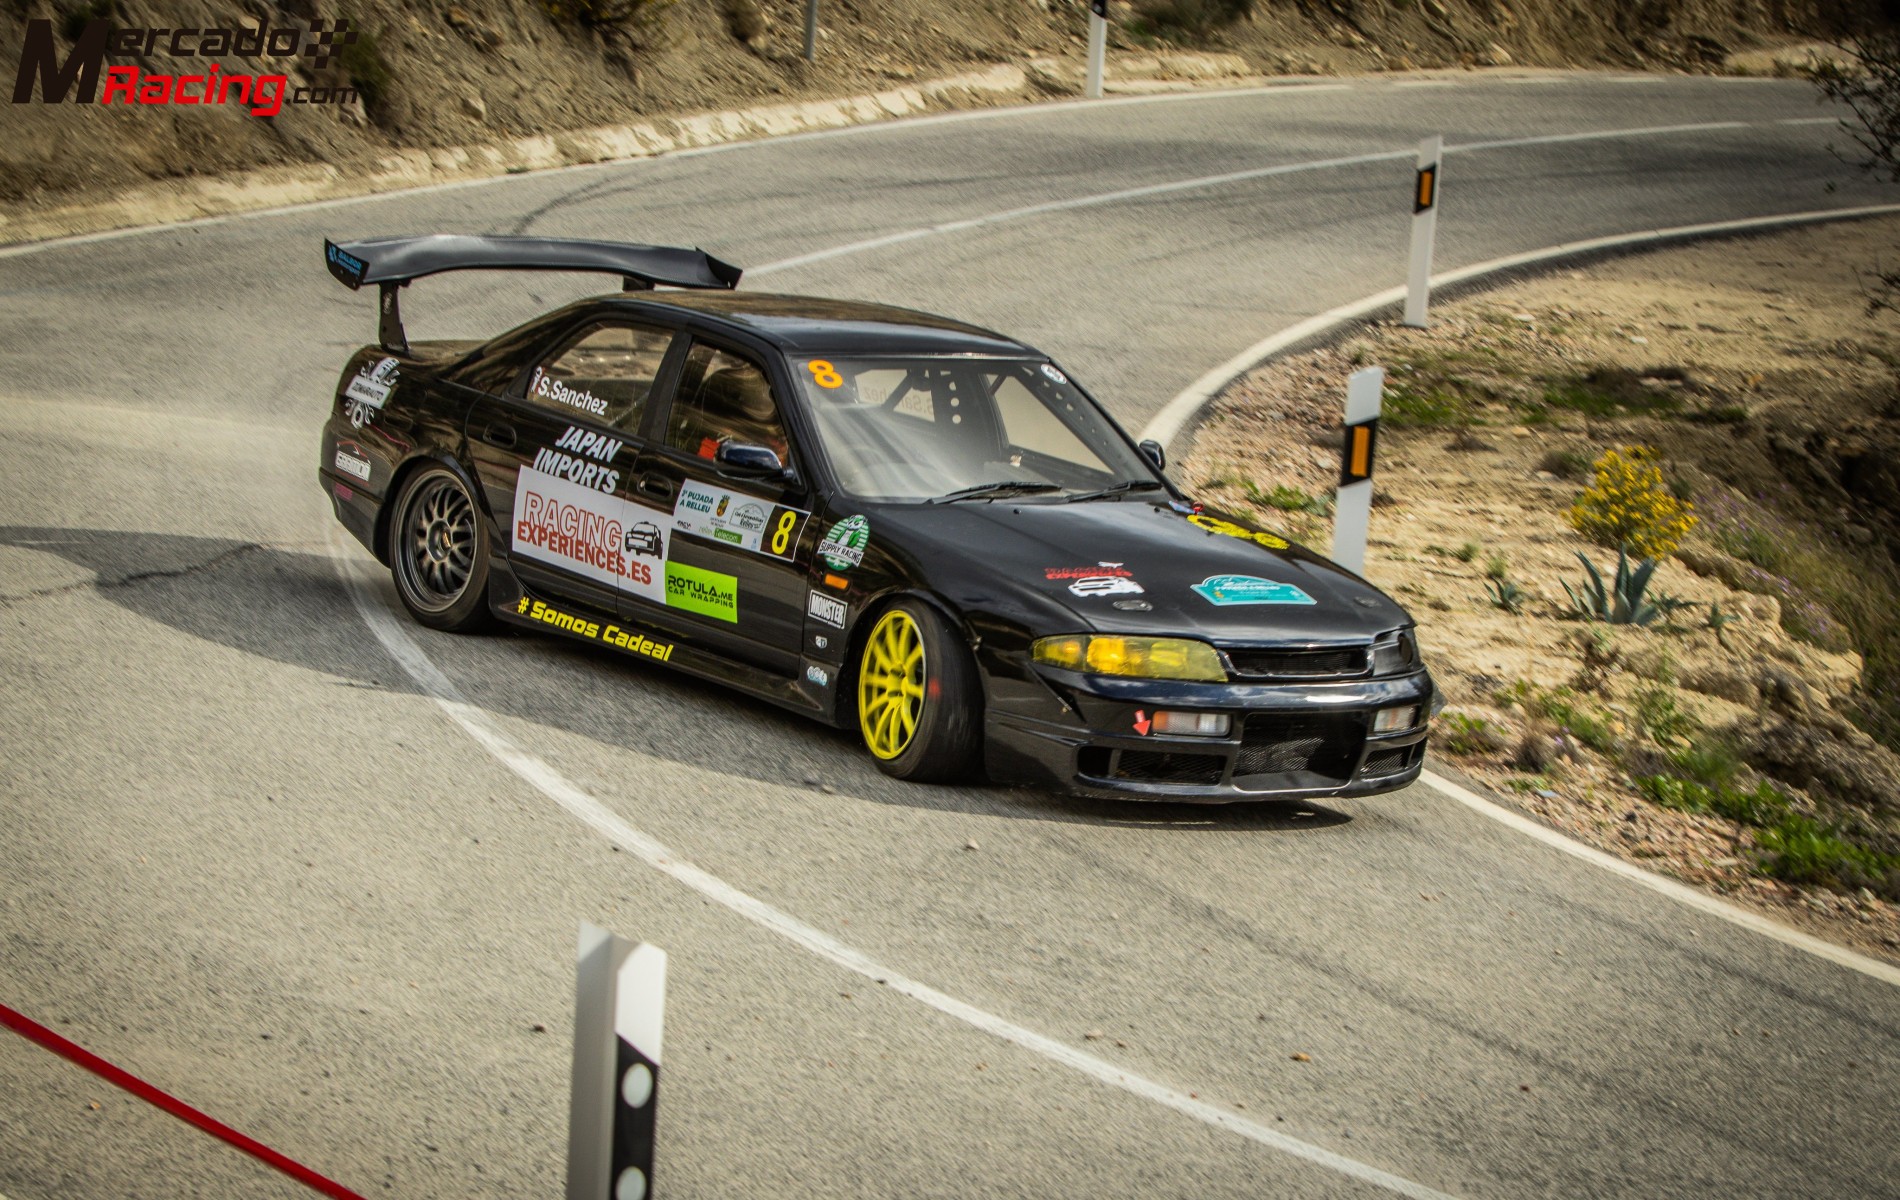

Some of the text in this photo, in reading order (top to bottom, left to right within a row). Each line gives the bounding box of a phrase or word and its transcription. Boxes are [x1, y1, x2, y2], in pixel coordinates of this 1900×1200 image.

[808, 359, 843, 388] 8
[537, 376, 608, 416] S.Sanchez
[555, 426, 623, 463] JAPAN
[533, 447, 620, 495] IMPORTS
[686, 501, 711, 514] RELLEU
[688, 491, 714, 505] PUJADA
[523, 490, 622, 553] RACING
[771, 510, 797, 555] 8
[517, 520, 652, 586] EXPERIENCES.ES
[819, 541, 862, 564] SUPPLY RACING
[668, 586, 734, 609] CAR WRAPPING
[810, 594, 844, 625] MONSTER
[531, 601, 600, 639] Somos
[602, 624, 674, 662] Cadeal
